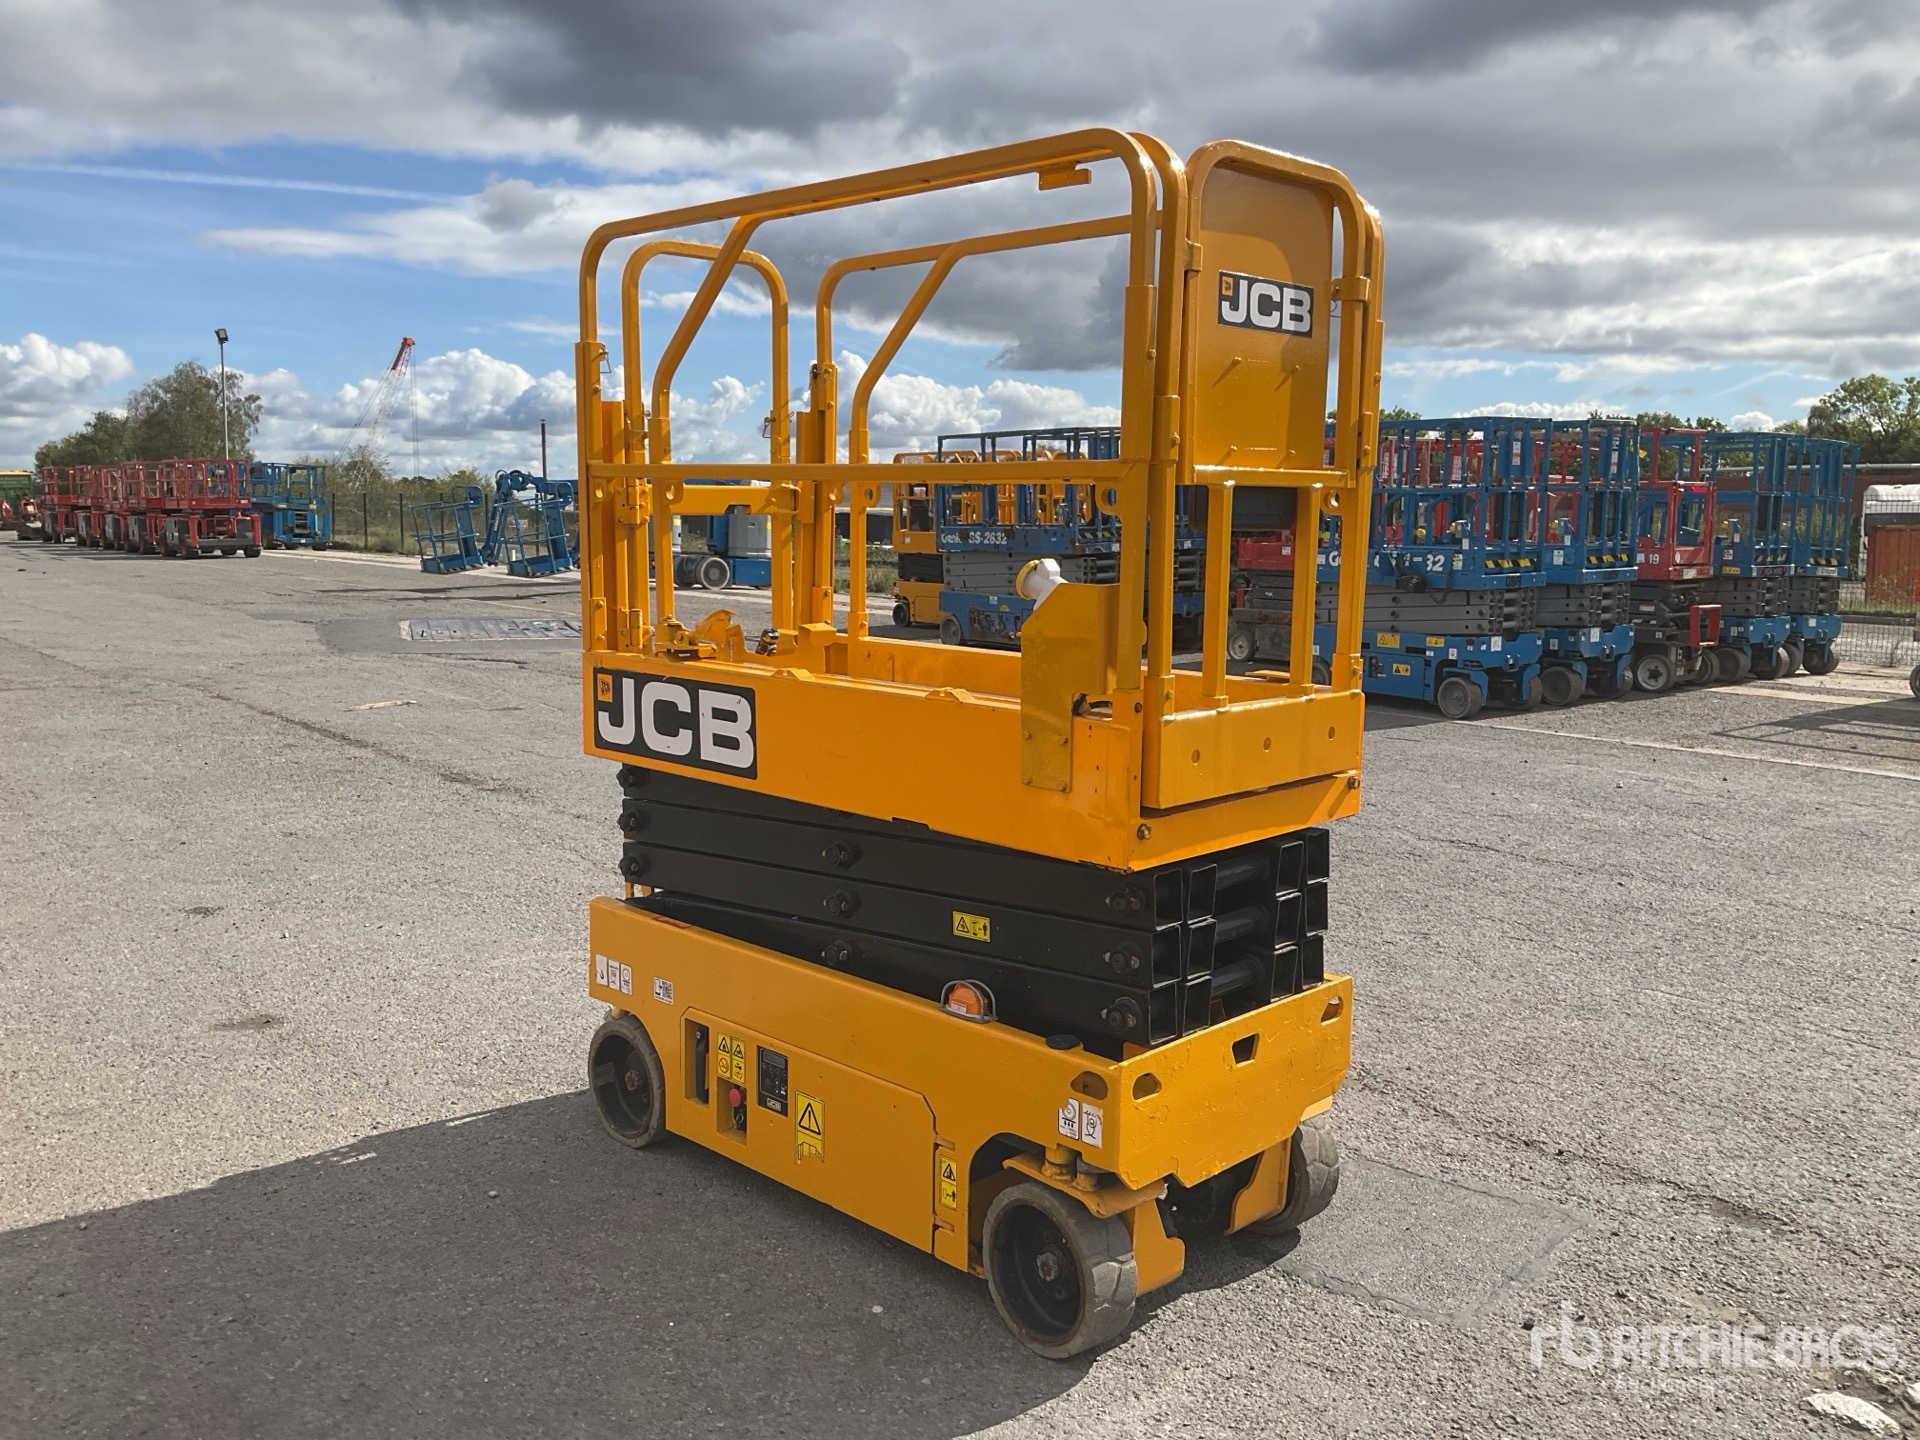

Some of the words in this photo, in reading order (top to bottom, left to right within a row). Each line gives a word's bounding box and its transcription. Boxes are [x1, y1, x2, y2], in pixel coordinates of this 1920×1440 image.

[1221, 279, 1311, 332] JCB
[1648, 553, 1660, 565] 19
[597, 677, 754, 769] JCB
